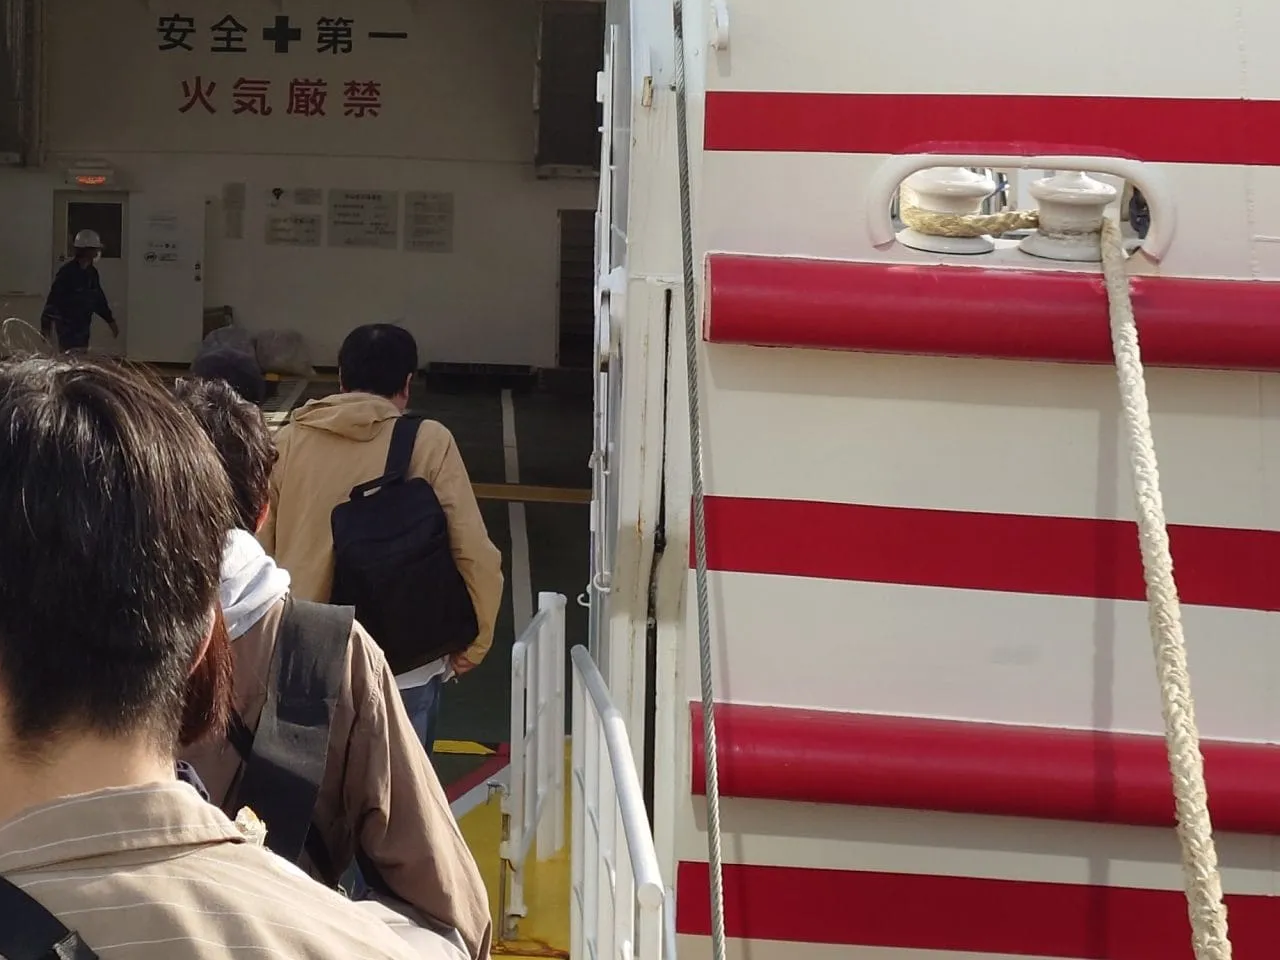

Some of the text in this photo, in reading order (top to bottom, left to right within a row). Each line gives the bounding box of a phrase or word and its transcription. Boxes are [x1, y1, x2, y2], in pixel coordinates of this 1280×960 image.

[156, 13, 408, 55] 安全 第一
[178, 75, 383, 119] 火気厳禁
